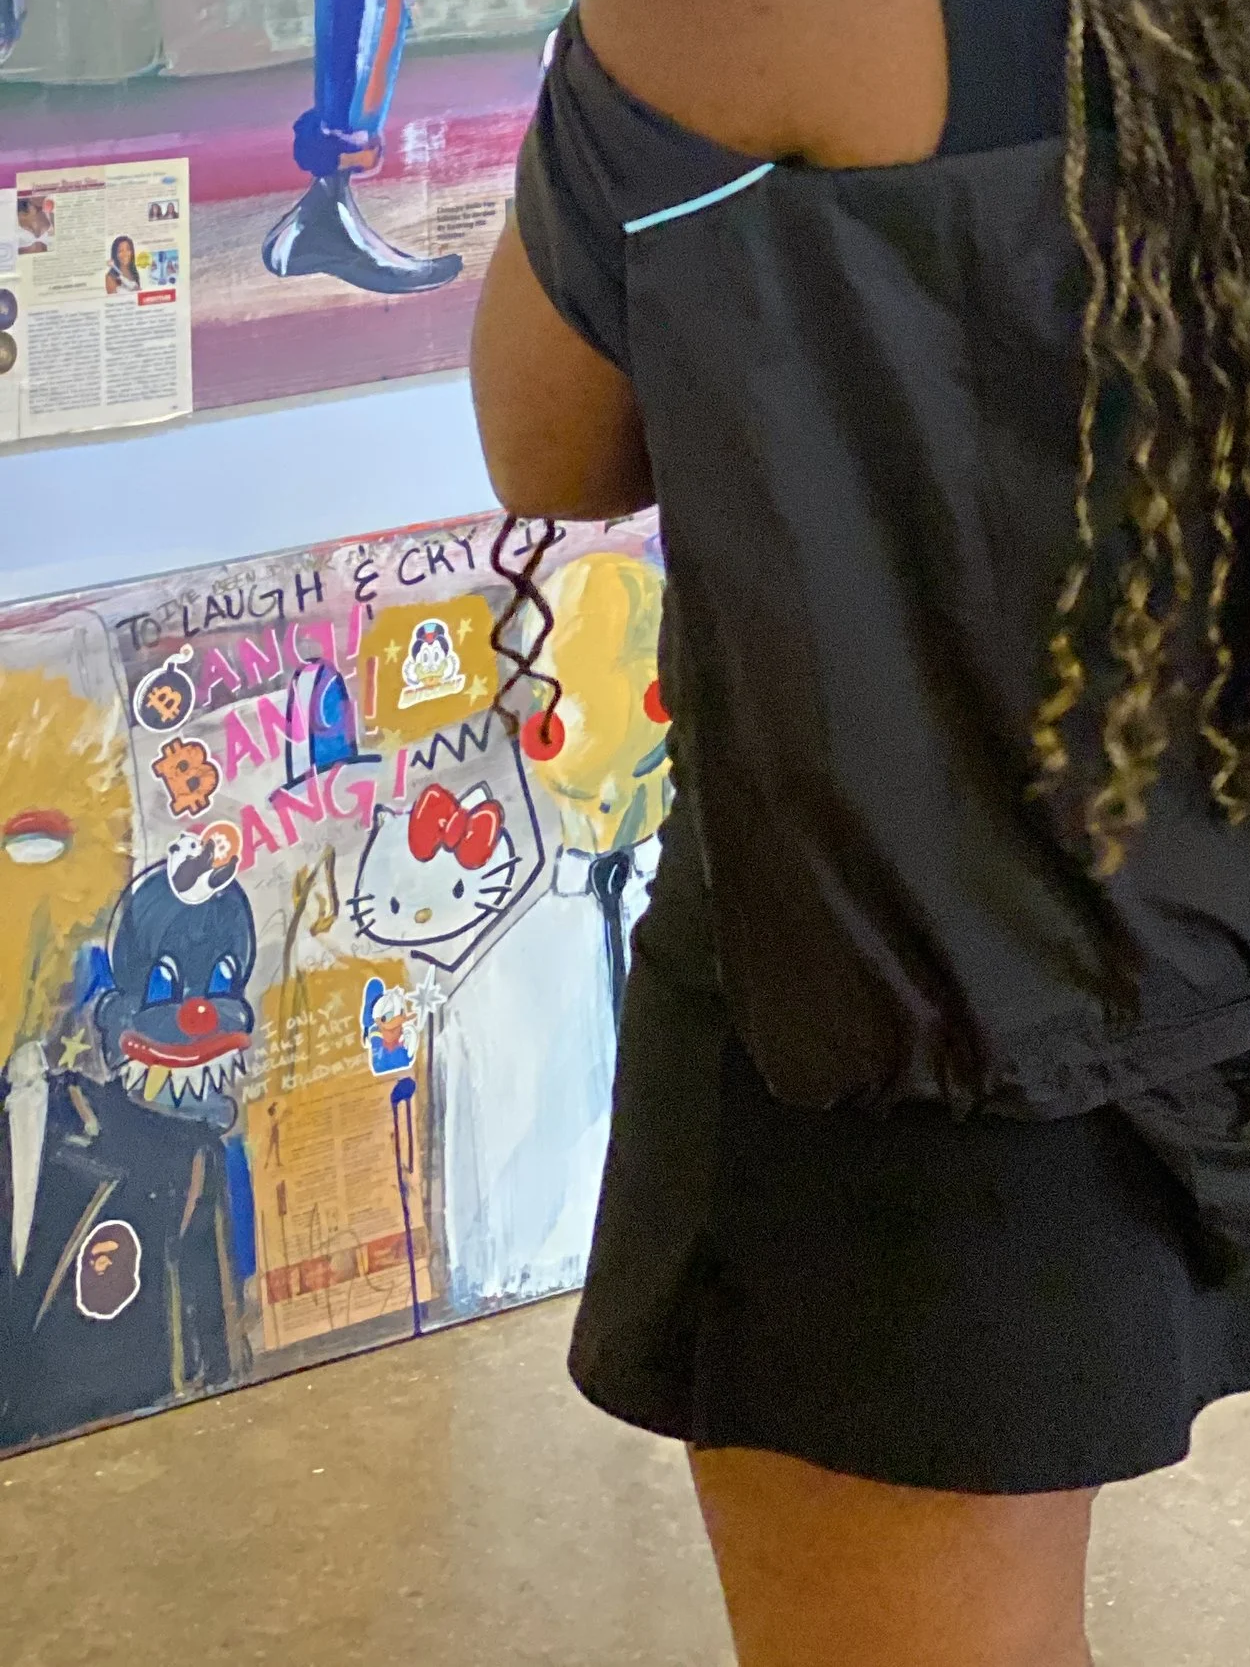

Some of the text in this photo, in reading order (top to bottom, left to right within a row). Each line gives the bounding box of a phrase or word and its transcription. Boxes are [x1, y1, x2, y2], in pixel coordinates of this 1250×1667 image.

[115, 612, 162, 651] TO
[182, 570, 324, 638] LAUGH
[192, 601, 363, 711] ANG!
[228, 748, 408, 872] ANG!
[254, 1015, 355, 1061] MAKE ART
[286, 1005, 334, 1031] ONLY
